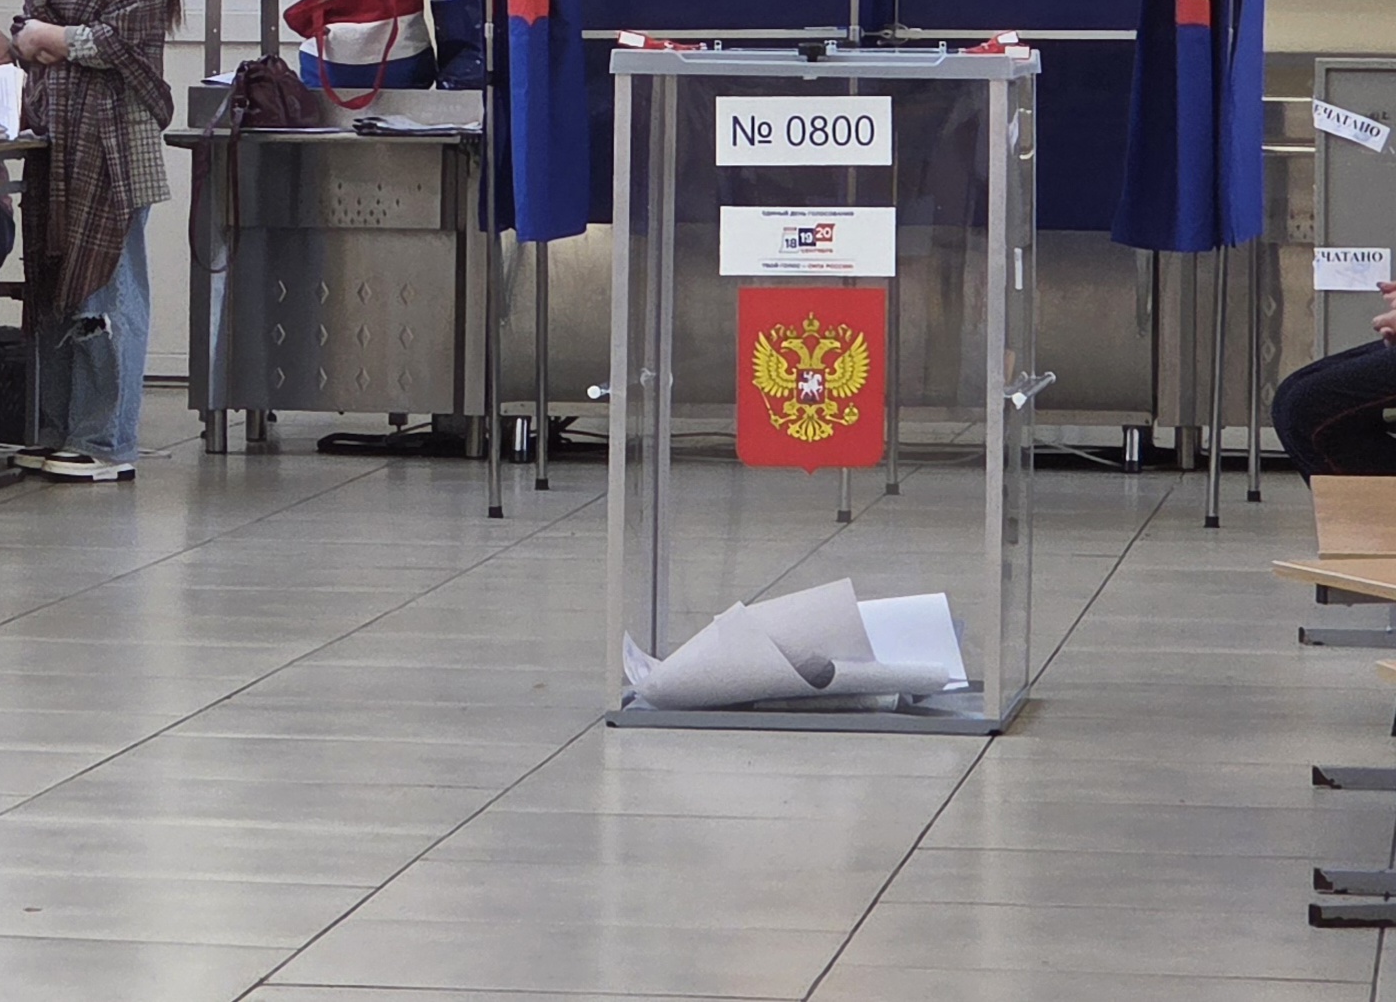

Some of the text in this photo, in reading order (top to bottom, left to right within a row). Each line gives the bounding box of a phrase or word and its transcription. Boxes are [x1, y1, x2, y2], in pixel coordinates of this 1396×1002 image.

[732, 115, 876, 146] № 0800
[785, 227, 833, 249] 18 19 20
